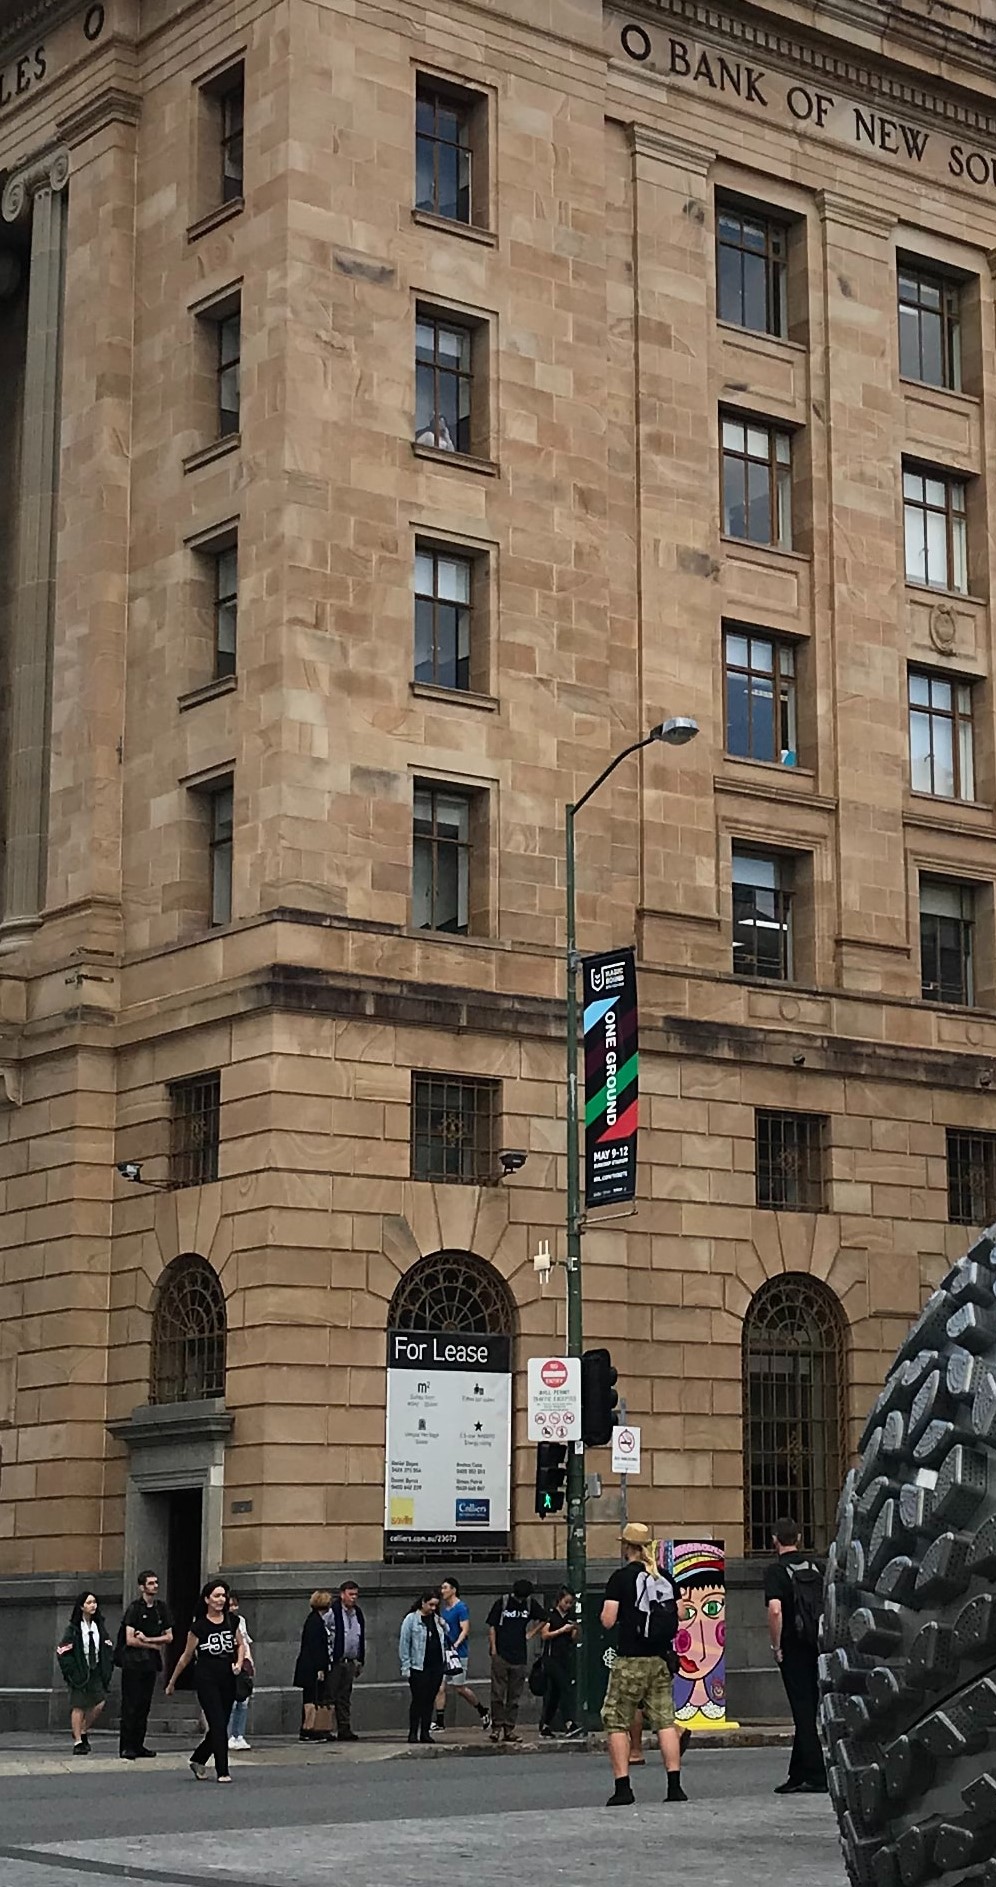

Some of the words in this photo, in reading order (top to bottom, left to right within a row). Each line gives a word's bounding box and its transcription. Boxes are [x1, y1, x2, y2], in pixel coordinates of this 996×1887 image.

[668, 37, 768, 106] BANK
[786, 86, 835, 128] OF
[855, 108, 929, 162] NEW
[604, 1011, 617, 1049] ONE
[605, 1051, 618, 1126] GROUND
[593, 1149, 611, 1162] MAY
[611, 1145, 629, 1159] 9-12
[395, 1336, 428, 1360] For
[433, 1338, 489, 1363] Lease
[458, 1503, 487, 1513] Colliers
